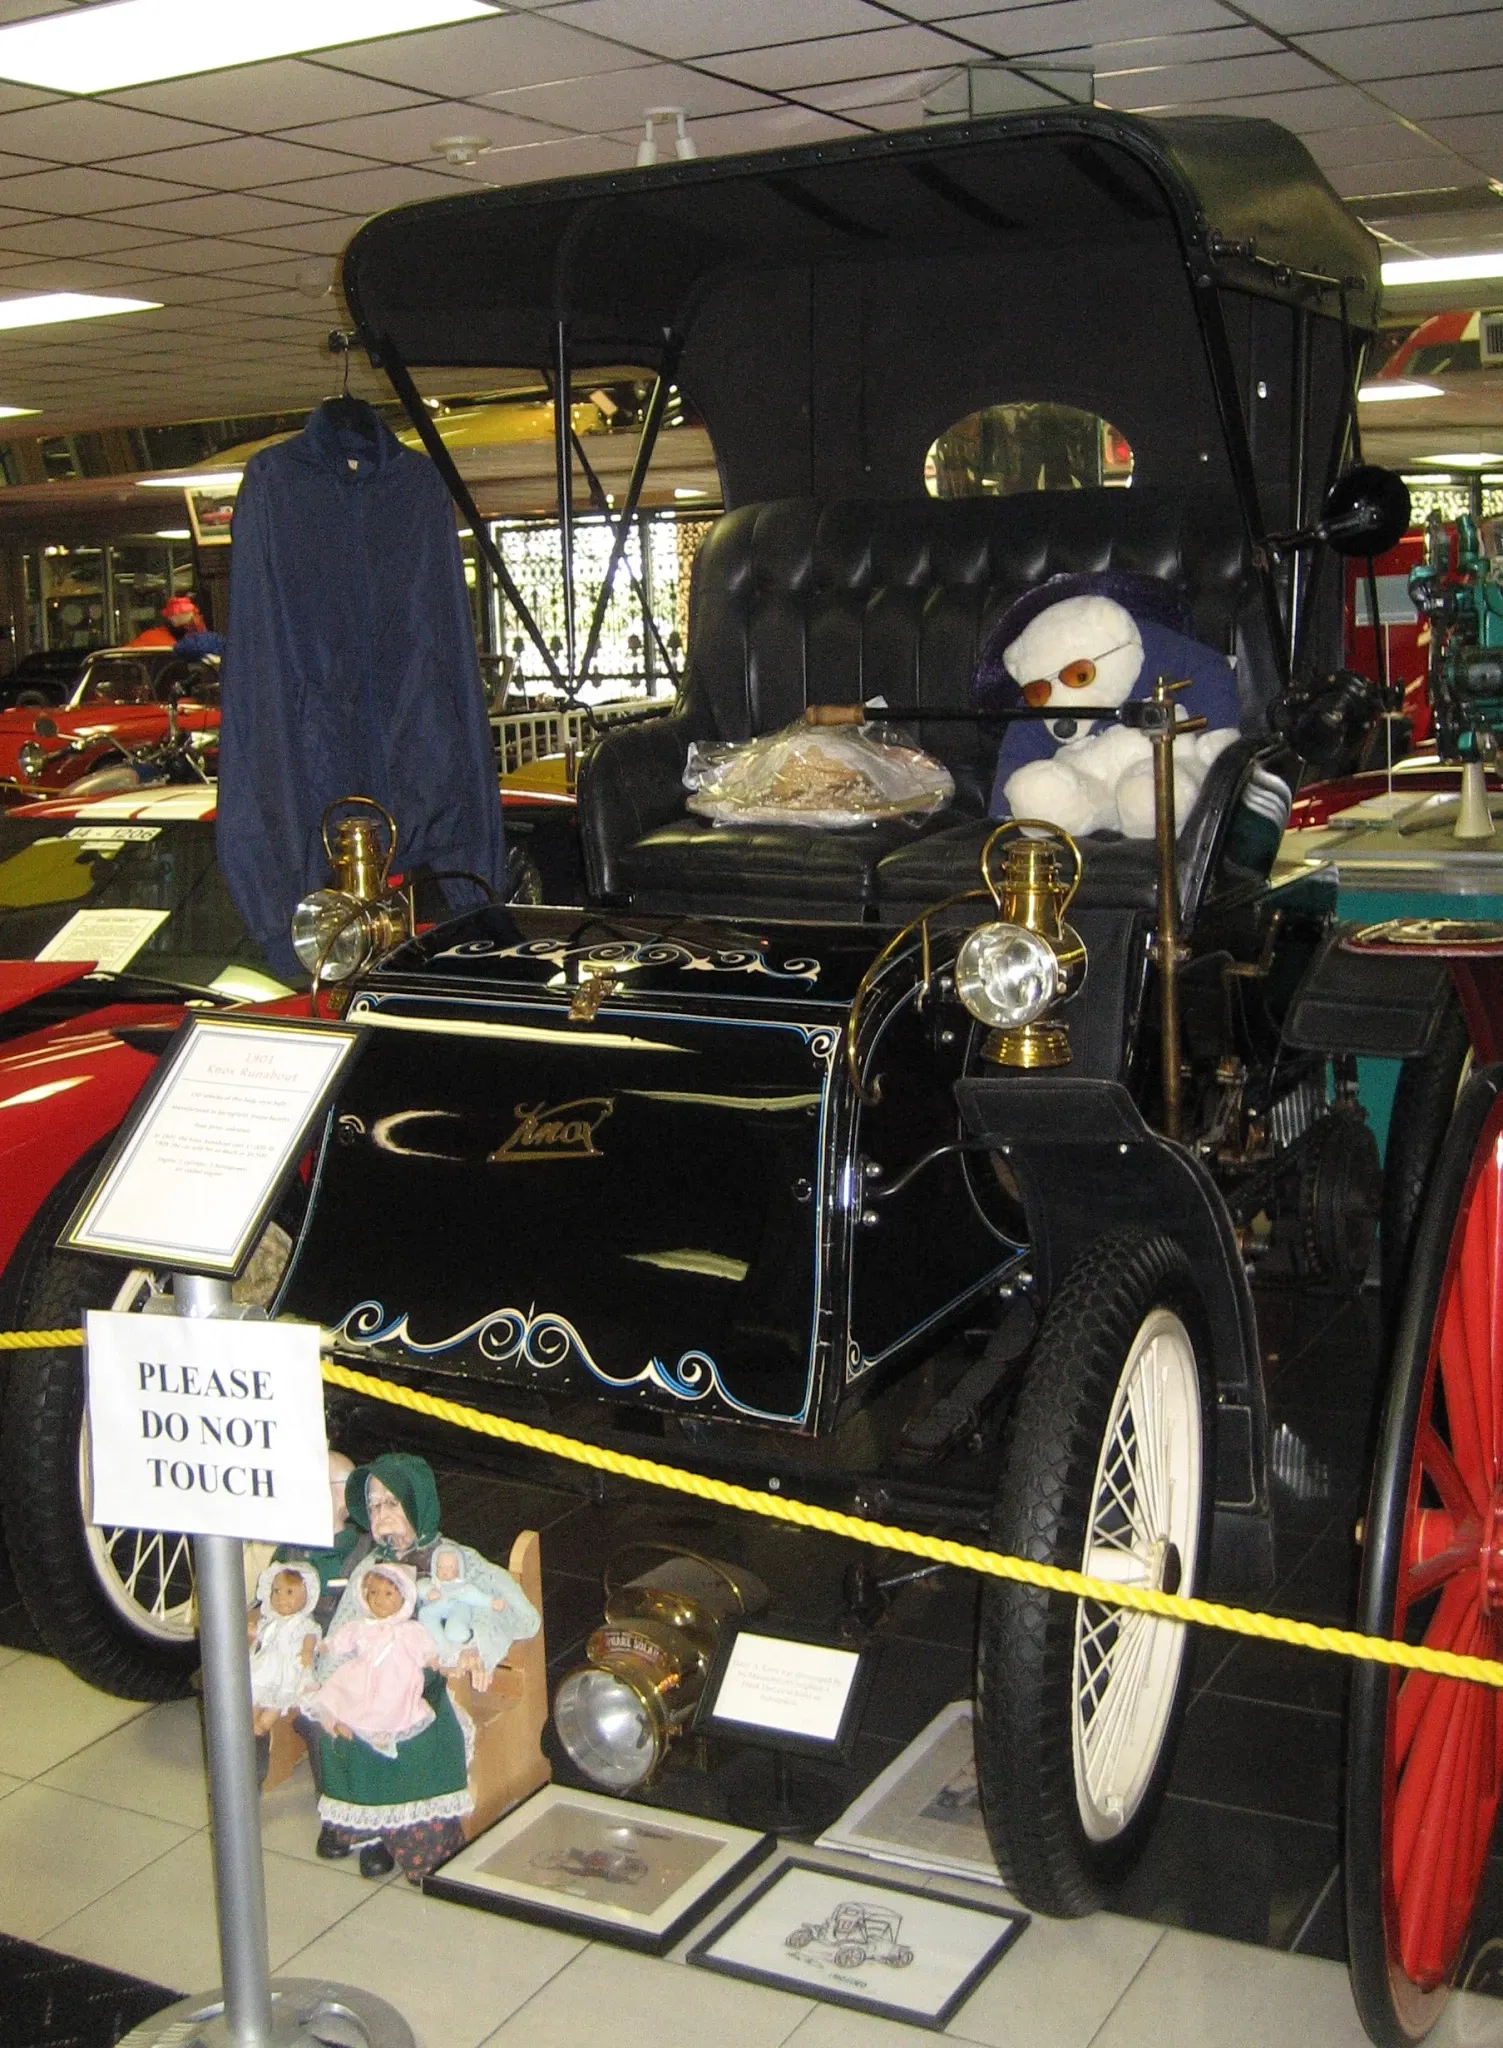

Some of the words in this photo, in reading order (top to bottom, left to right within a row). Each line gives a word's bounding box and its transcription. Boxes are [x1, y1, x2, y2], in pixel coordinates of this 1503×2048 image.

[207, 1065, 235, 1077] Knox
[240, 1066, 299, 1083] Runabout
[137, 1361, 275, 1401] PLEASE
[139, 1409, 189, 1443] DO
[198, 1416, 277, 1450] NOT
[146, 1458, 277, 1499] TOUCH
